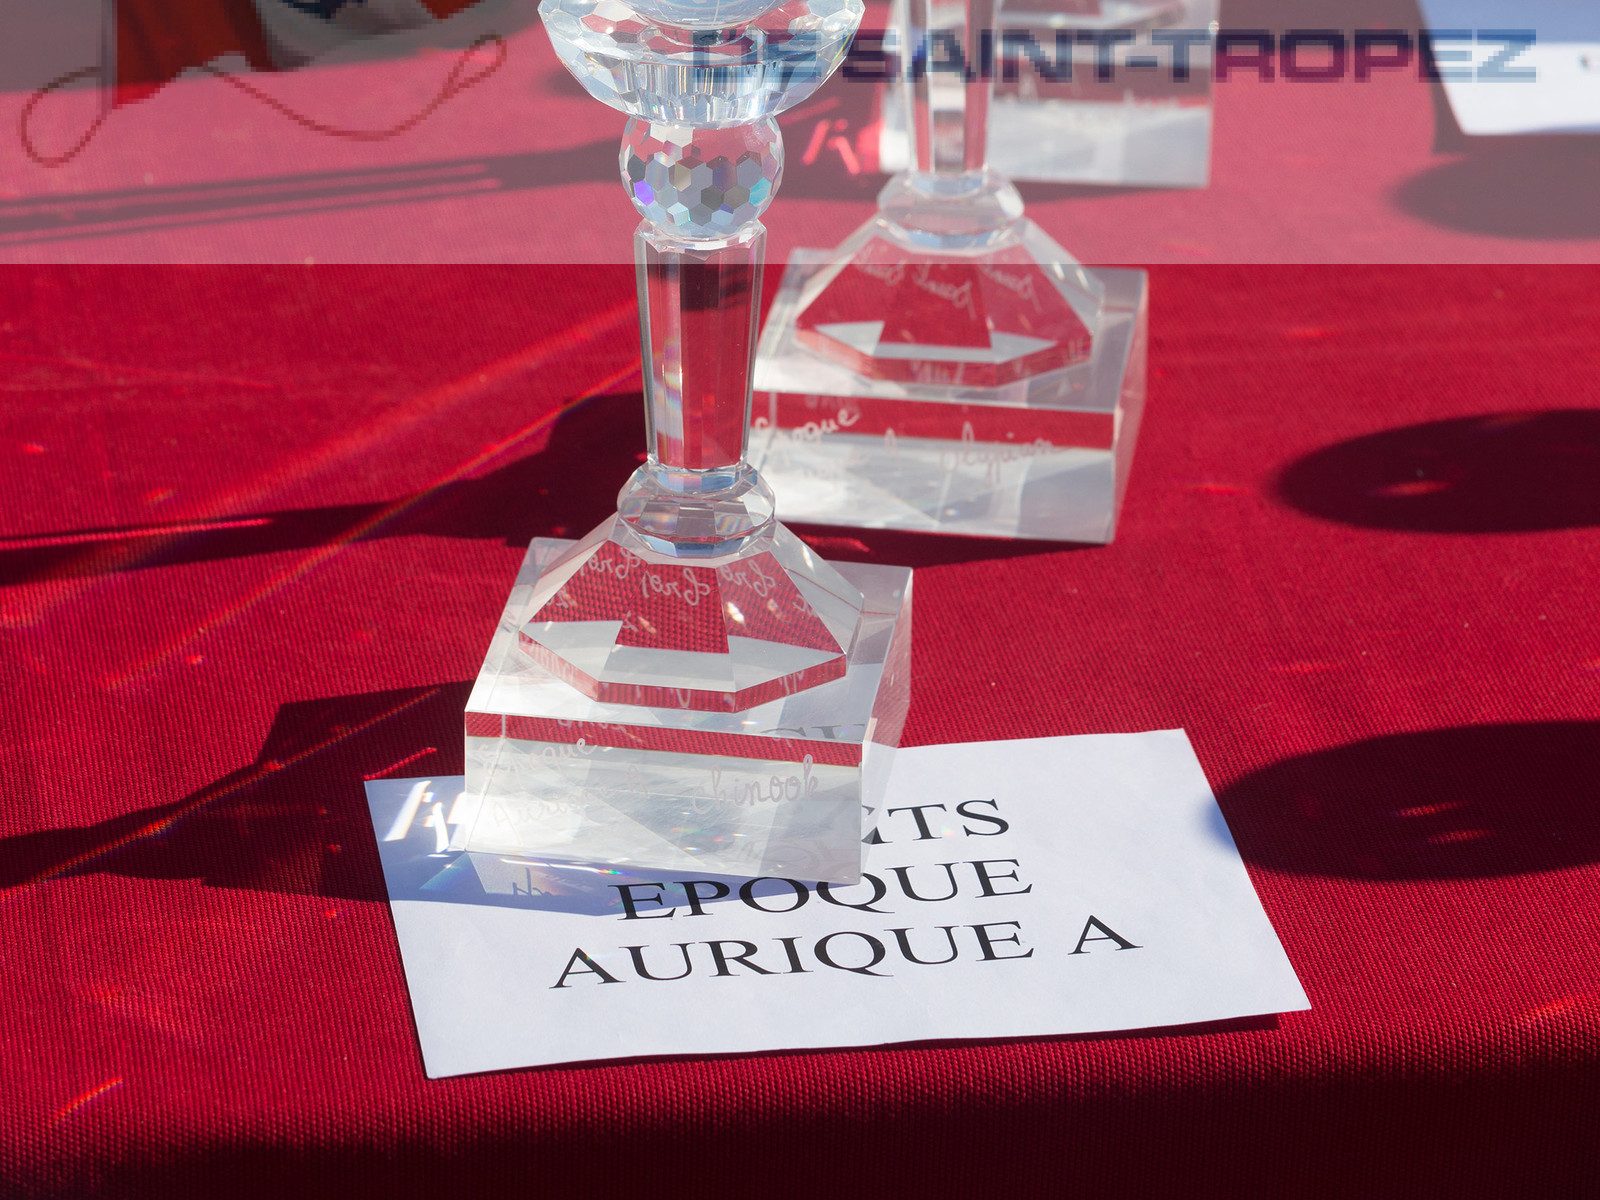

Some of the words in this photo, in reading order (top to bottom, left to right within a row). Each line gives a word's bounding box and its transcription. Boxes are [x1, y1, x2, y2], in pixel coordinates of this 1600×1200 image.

[608, 858, 1033, 921] EPOQUE
[549, 919, 1034, 990] AURIQUE
[1067, 914, 1144, 955] A
